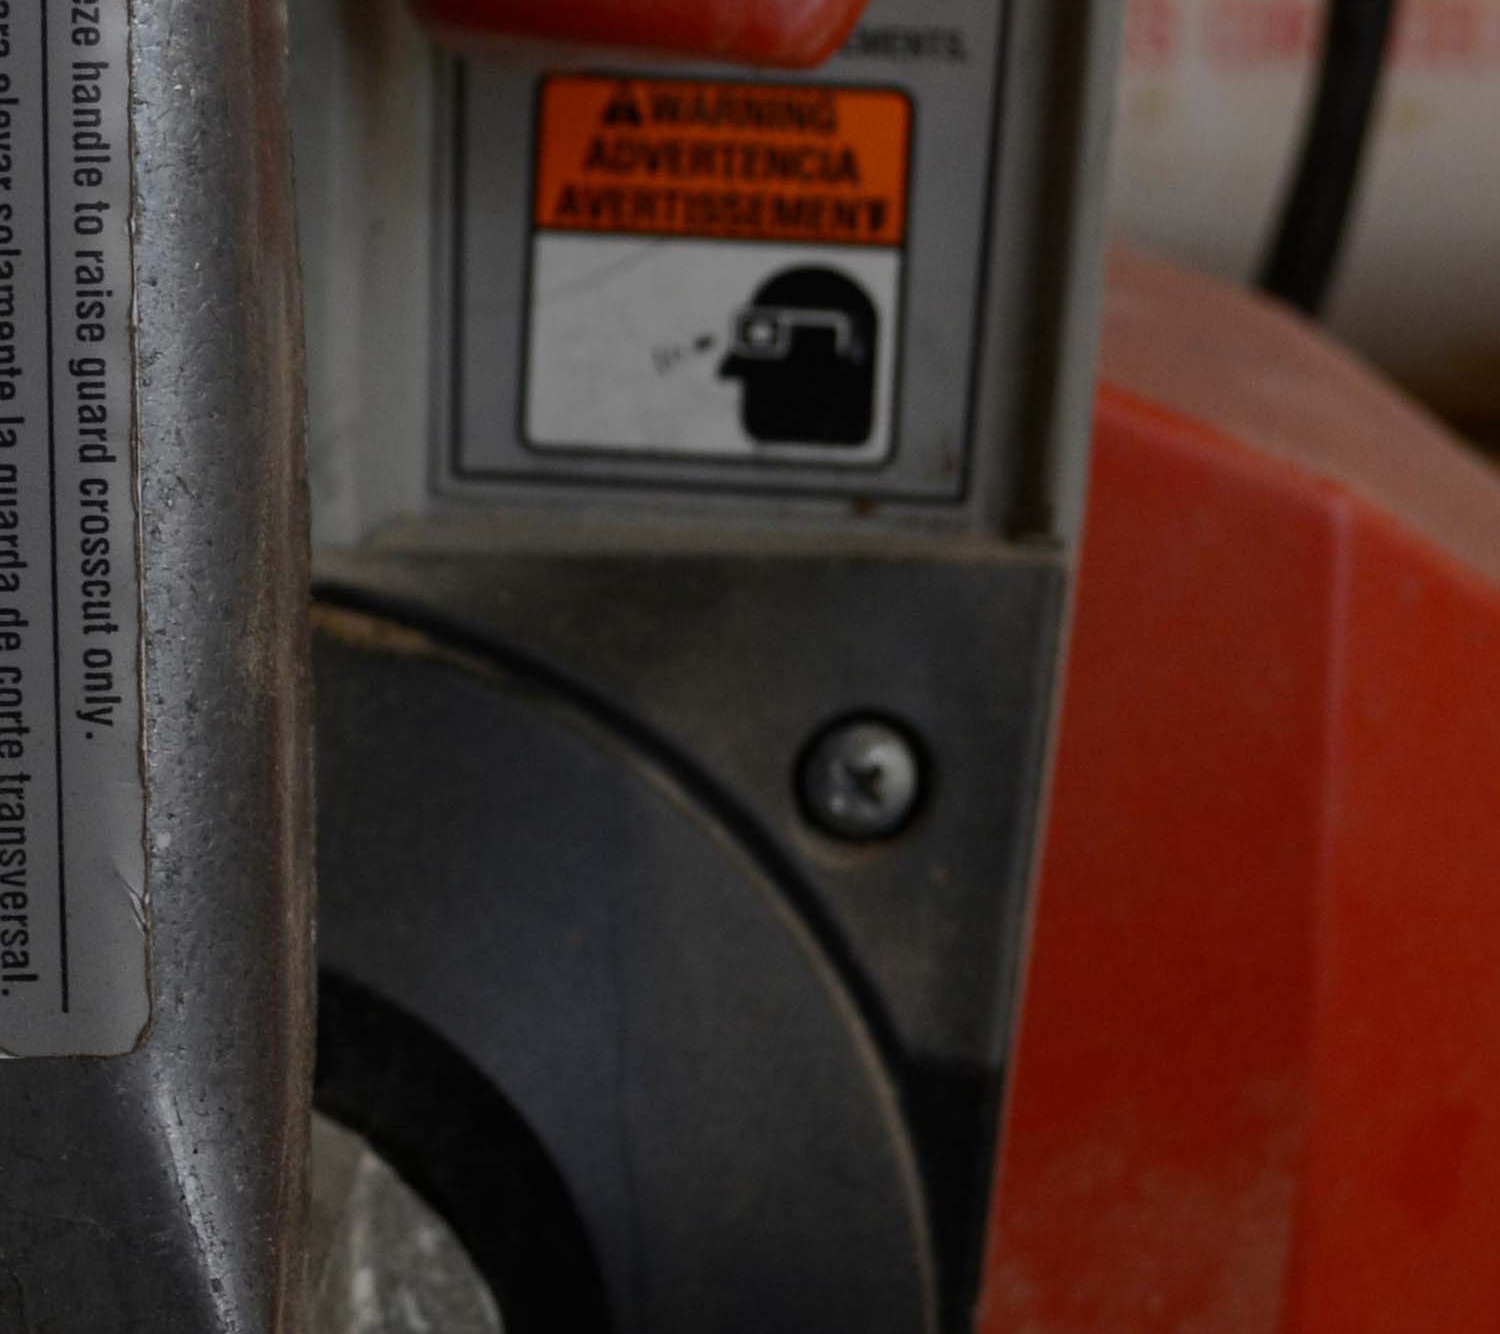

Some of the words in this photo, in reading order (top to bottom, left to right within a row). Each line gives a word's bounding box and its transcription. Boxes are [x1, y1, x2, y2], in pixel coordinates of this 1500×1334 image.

[72, 61, 112, 188] handle
[650, 91, 838, 133] WARNING
[583, 135, 861, 184] ADVERTENCIA
[74, 201, 110, 236] to
[556, 183, 891, 232] AVERTISSEMENT
[76, 250, 114, 343] raise
[69, 357, 117, 464] guard
[78, 477, 119, 635] crosscut
[76, 647, 122, 740] only.
